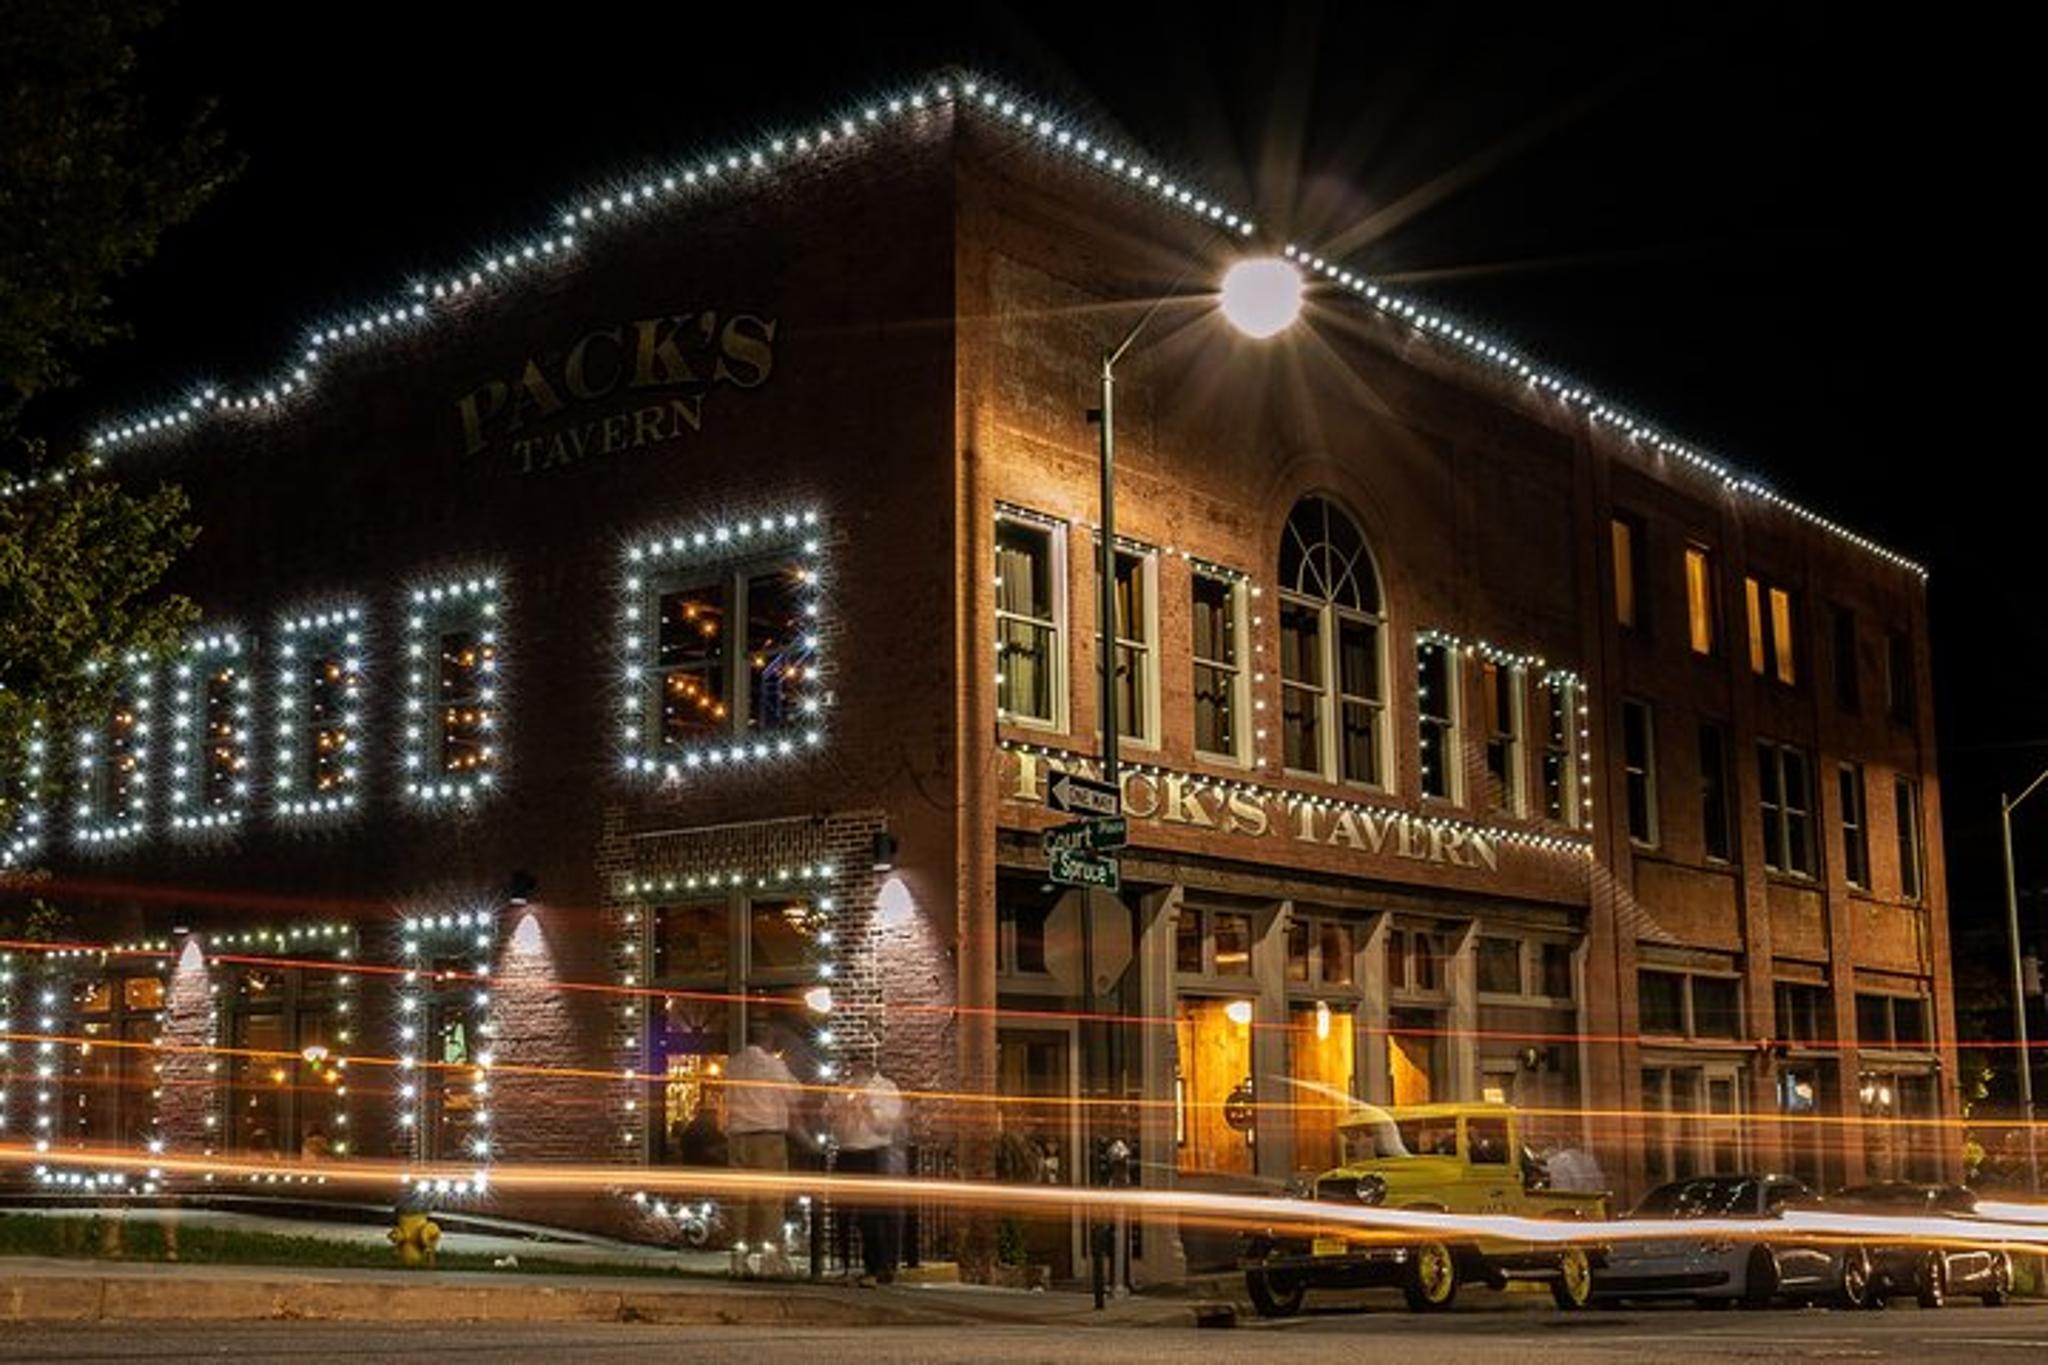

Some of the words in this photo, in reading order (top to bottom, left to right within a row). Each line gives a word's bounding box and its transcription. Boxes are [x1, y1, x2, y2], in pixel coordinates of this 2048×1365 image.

[457, 309, 778, 457] PACK'S
[512, 392, 707, 473] TAVERN
[1043, 824, 1092, 854] Court
[1060, 850, 1107, 884] Spruce
[1287, 798, 1499, 872] TAVERN
